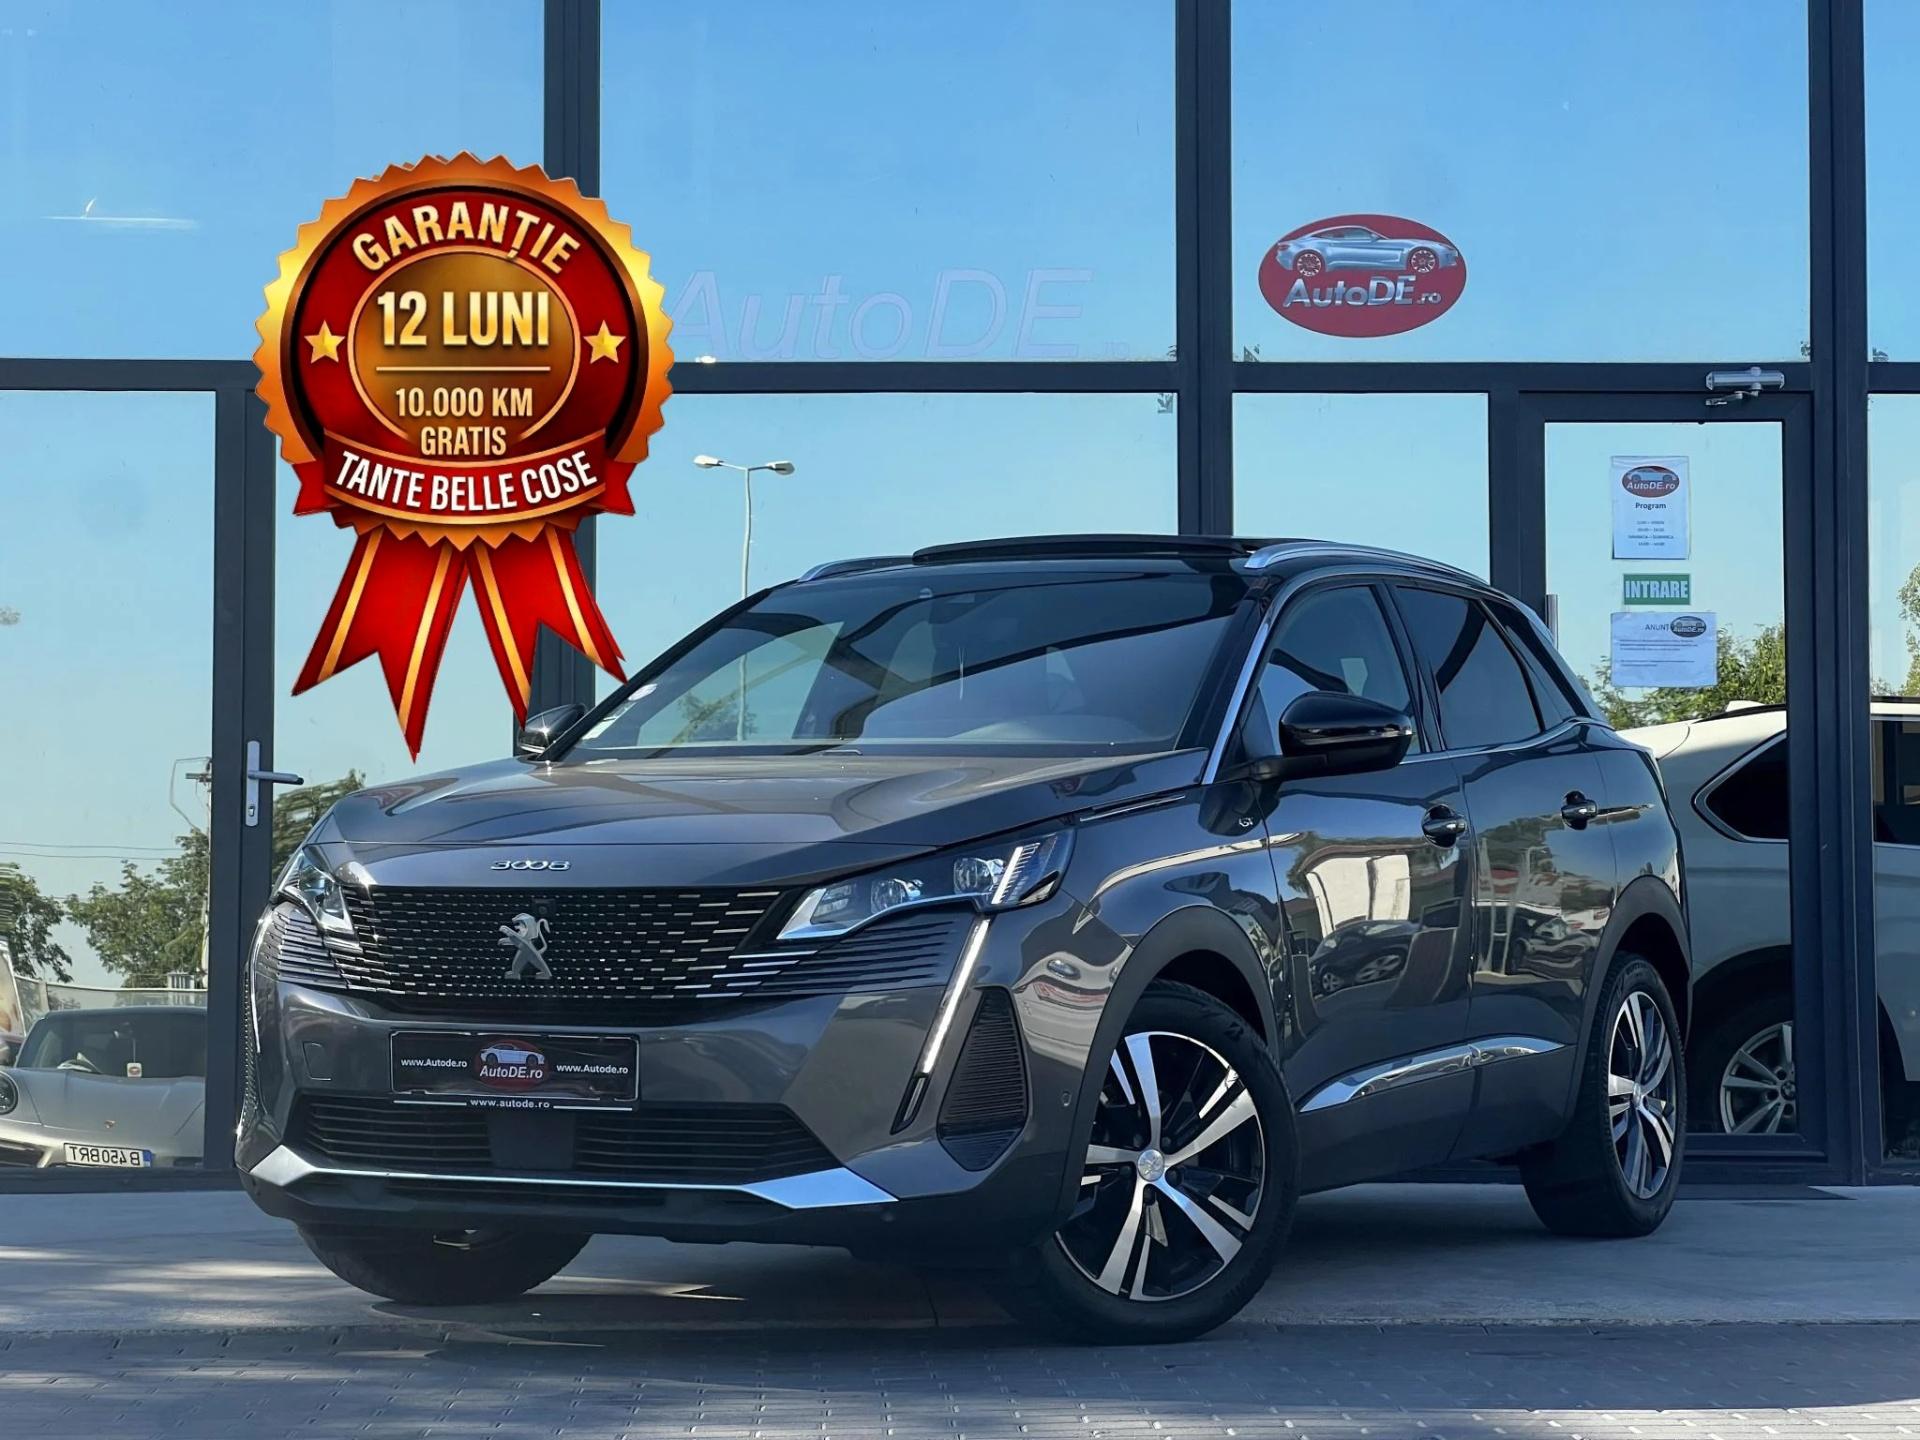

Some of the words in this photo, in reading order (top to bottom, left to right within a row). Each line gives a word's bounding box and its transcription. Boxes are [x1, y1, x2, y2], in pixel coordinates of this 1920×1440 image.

[1626, 481, 1676, 490] AutoDE.ro
[1635, 502, 1667, 511] Program
[1625, 580, 1689, 598] INTRARE
[490, 860, 571, 871] 3008
[400, 1058, 468, 1069] www.Autode.ro
[556, 1063, 629, 1075] www.Autode.ro
[479, 1065, 544, 1079] AutoDE.ro
[470, 1098, 550, 1109] www.autode.ro
